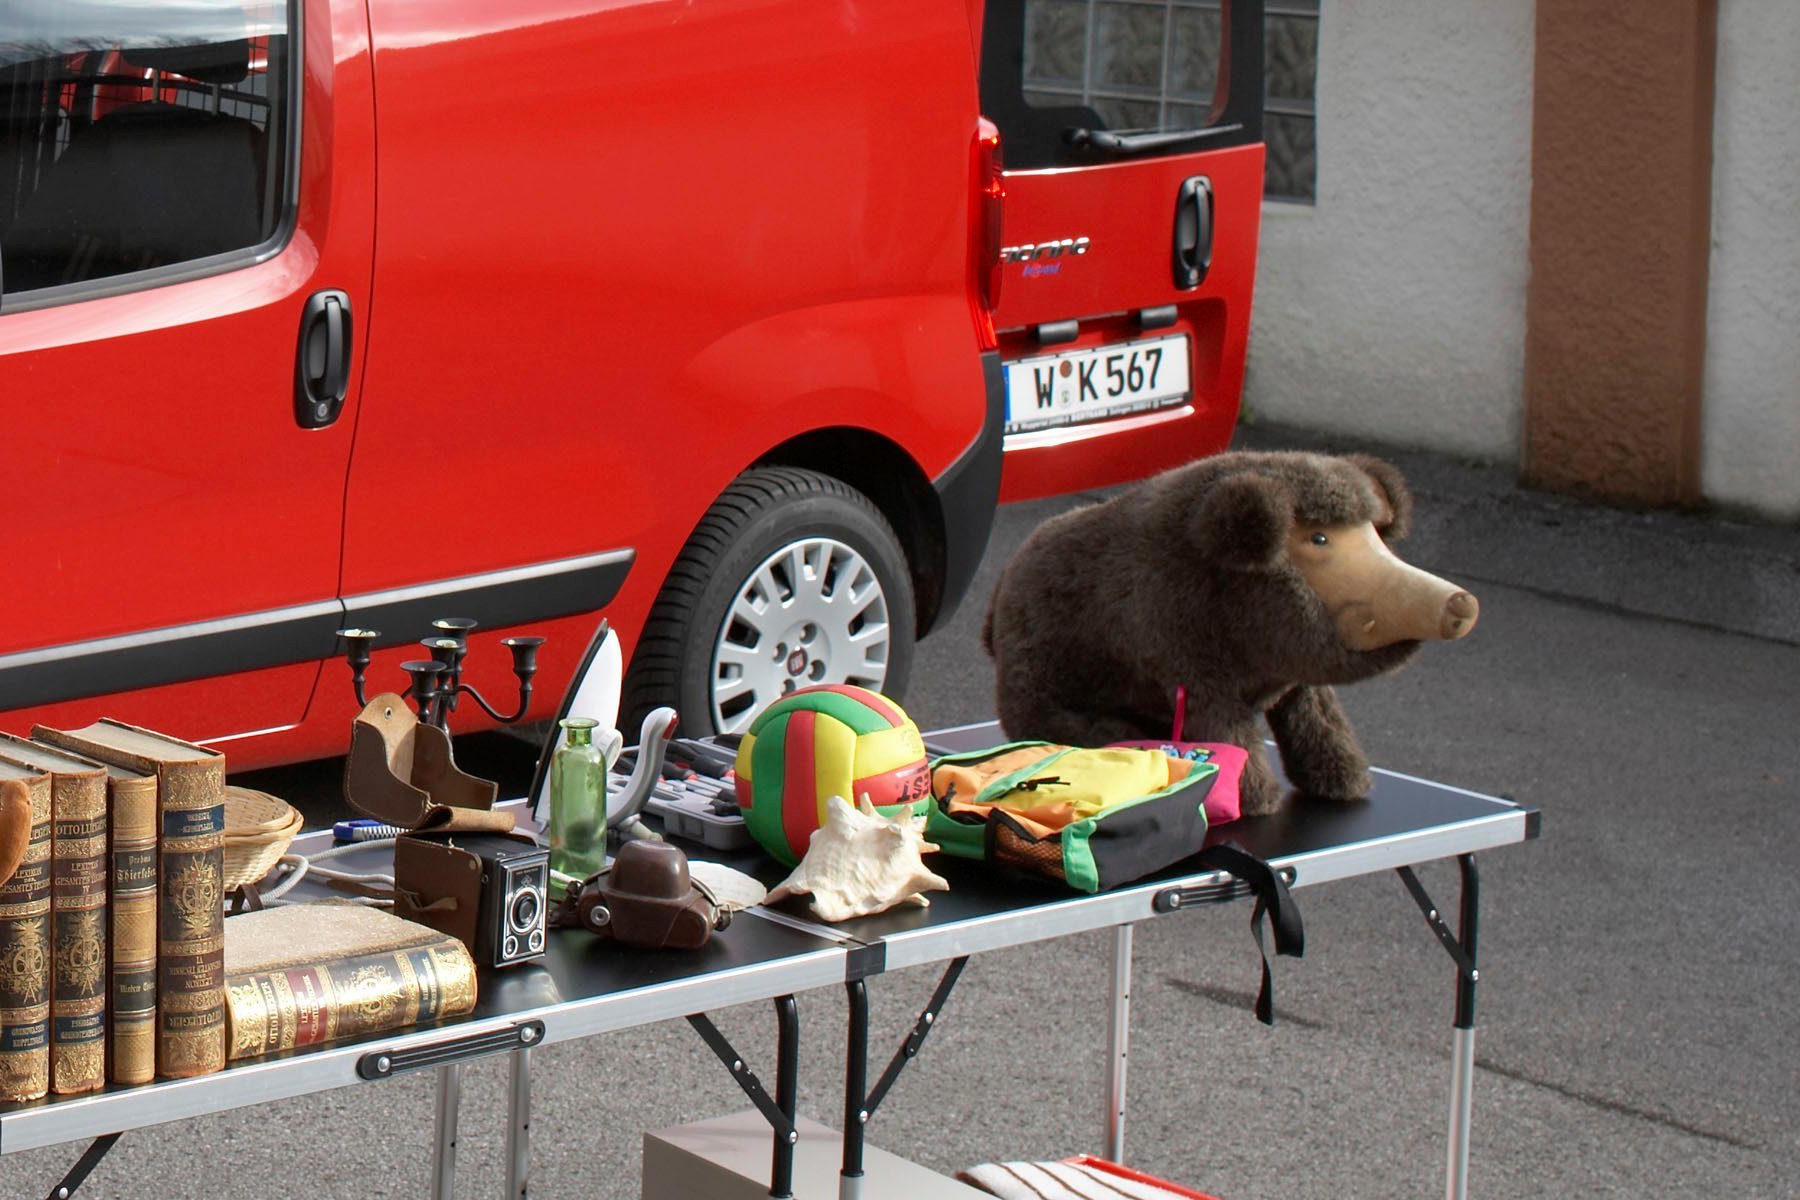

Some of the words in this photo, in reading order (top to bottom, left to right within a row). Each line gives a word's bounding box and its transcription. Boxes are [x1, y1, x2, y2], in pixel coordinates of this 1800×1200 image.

[1034, 365, 1054, 409] W
[1079, 358, 1098, 402] K
[1106, 348, 1162, 397] 567
[56, 824, 80, 835] OTTO
[268, 1019, 278, 1044] OTTO
